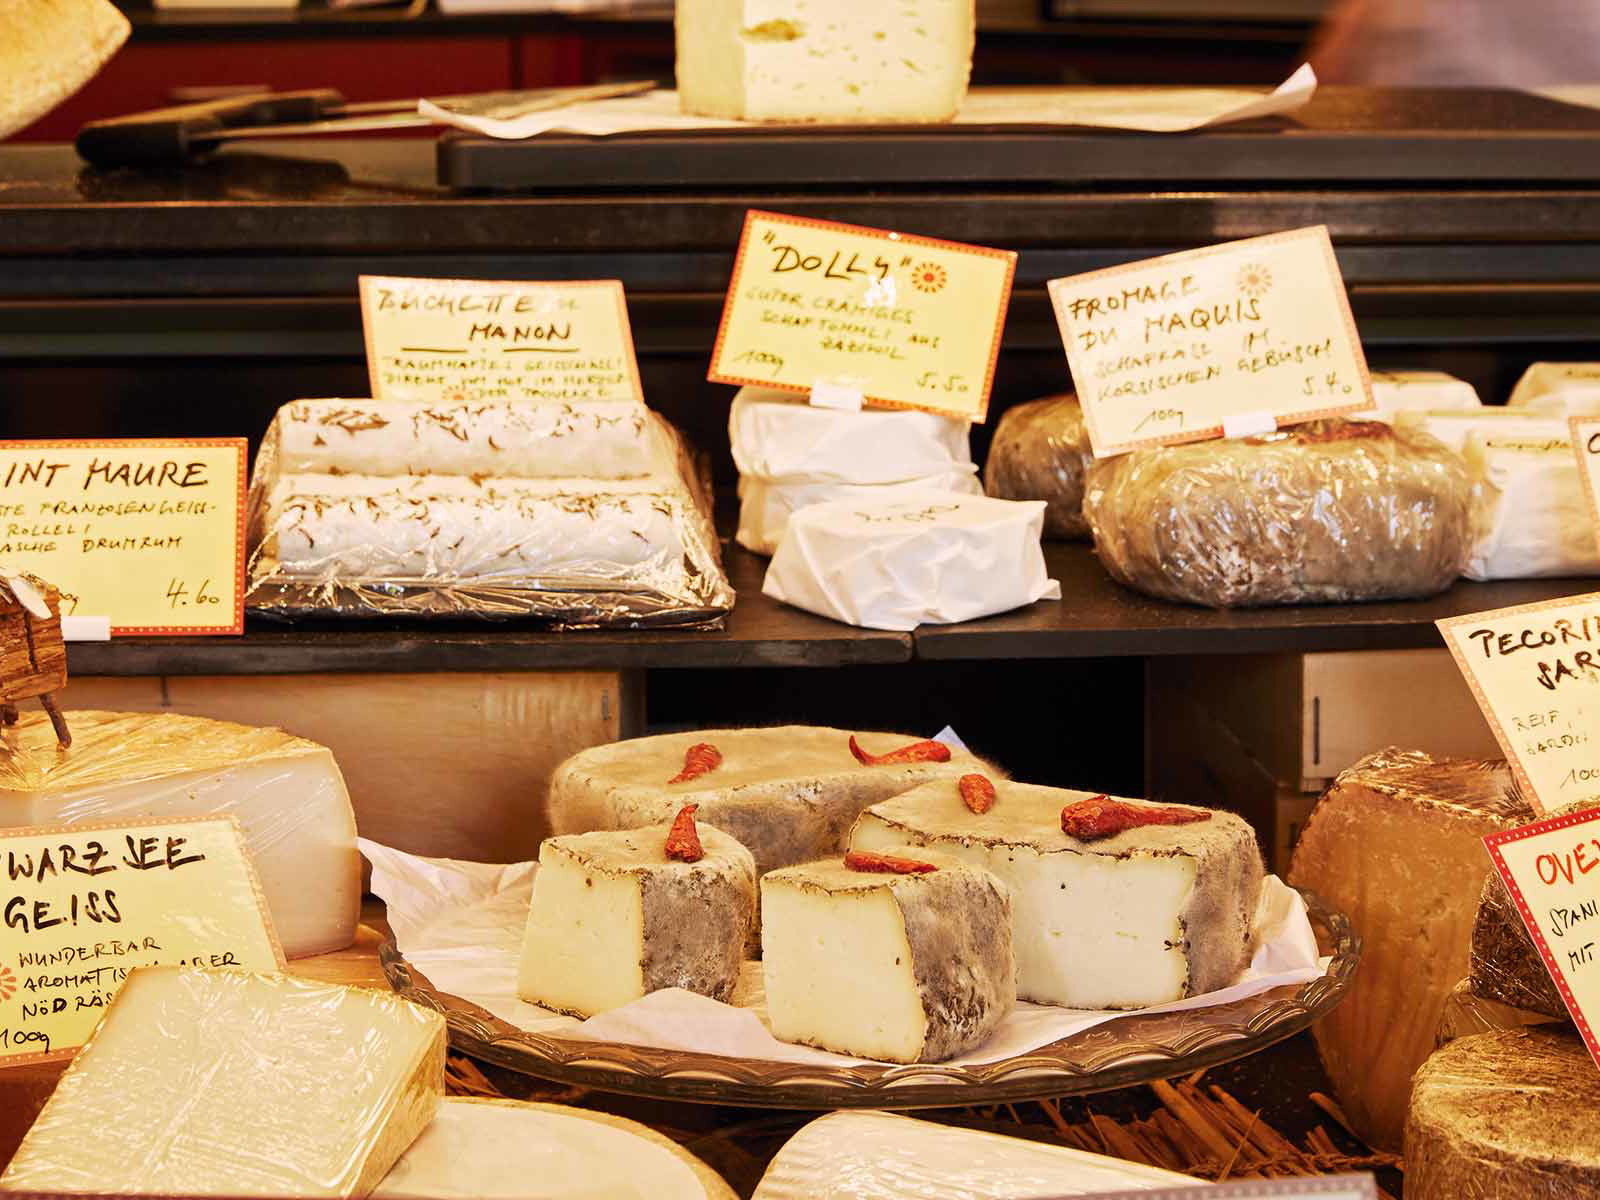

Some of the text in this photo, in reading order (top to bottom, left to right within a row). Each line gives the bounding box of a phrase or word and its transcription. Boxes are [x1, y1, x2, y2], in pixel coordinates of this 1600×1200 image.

[1068, 276, 1199, 321] FROMAGE
[468, 321, 572, 343] MANON
[1079, 297, 1261, 351] DU MAQUIS
[915, 370, 970, 393] 5.50
[83, 457, 209, 491] MAURE
[166, 577, 220, 609] 4.60
[1468, 614, 1600, 660] PECORI
[1536, 648, 1600, 691] SAR
[4, 889, 122, 935] GEISS
[19, 935, 162, 969] WUNDERBAR
[1567, 942, 1596, 973] MIT
[0, 1027, 50, 1054] 100g
